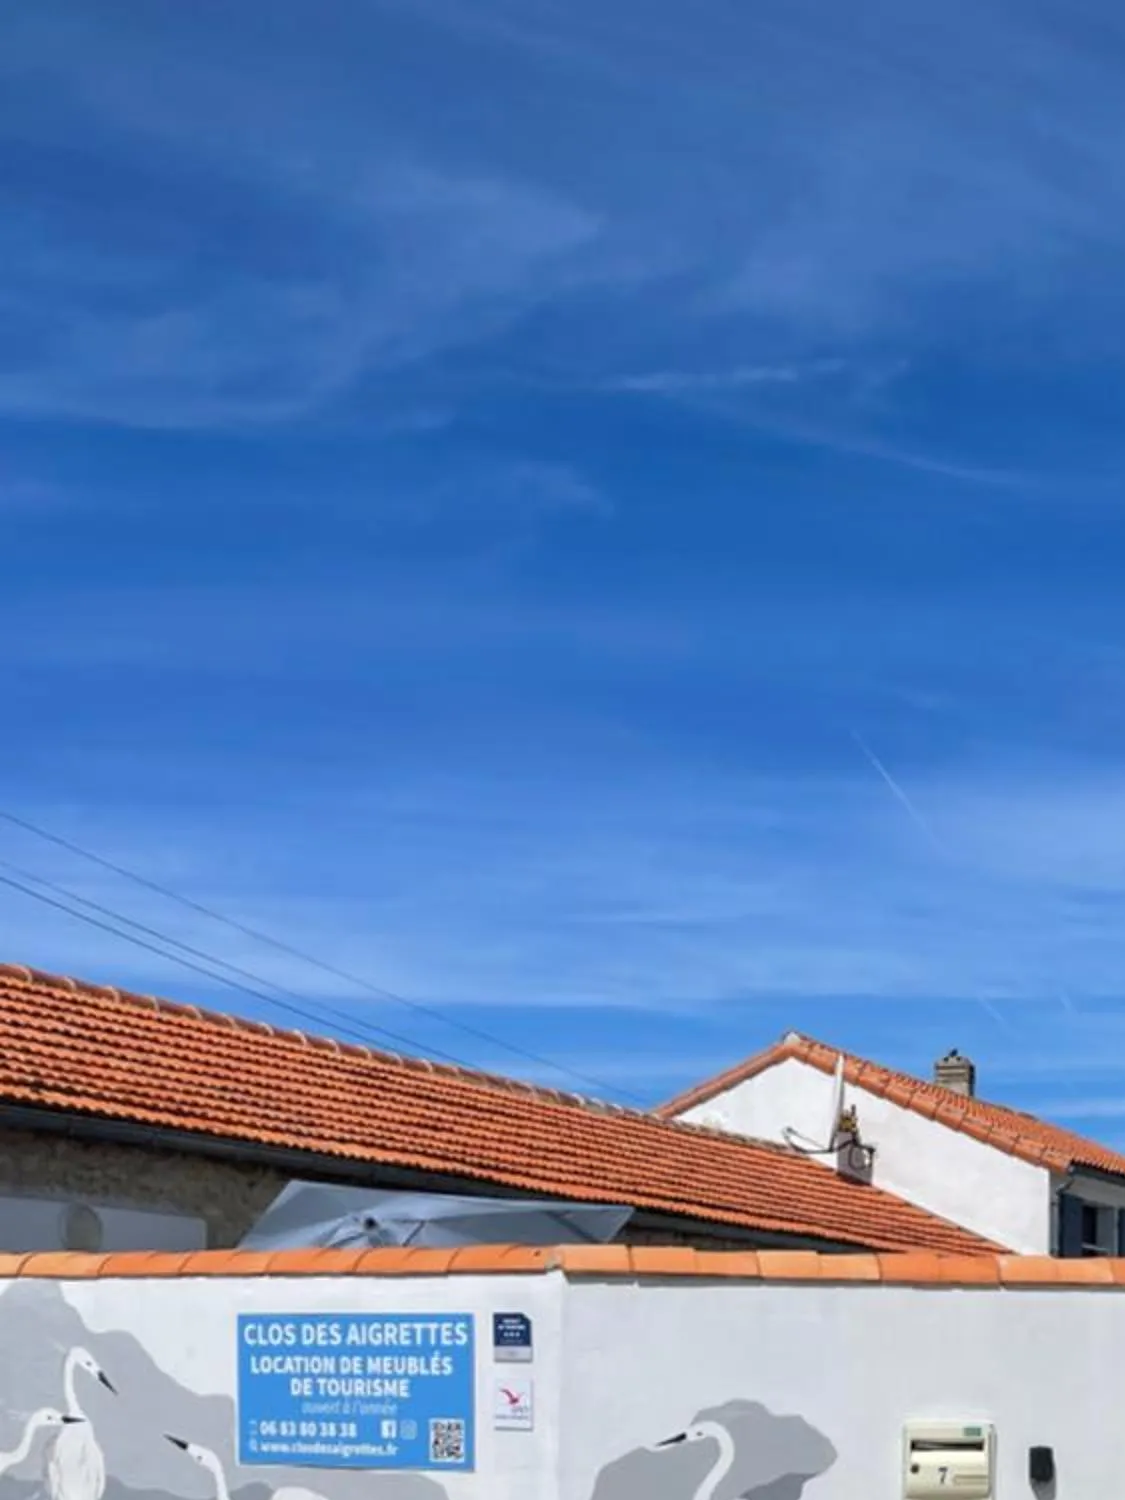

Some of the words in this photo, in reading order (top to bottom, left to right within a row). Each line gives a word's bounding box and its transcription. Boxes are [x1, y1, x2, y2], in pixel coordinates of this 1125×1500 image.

[243, 1322, 296, 1346] CLOS
[301, 1322, 342, 1346] DES
[346, 1322, 468, 1346] AIGRETTES
[250, 1355, 336, 1374] LOCATION
[339, 1355, 363, 1374] DE
[367, 1350, 453, 1375] MEUBLÉS
[290, 1377, 313, 1396] DE
[316, 1377, 410, 1398] TOURISME
[938, 1466, 948, 1485] 7
